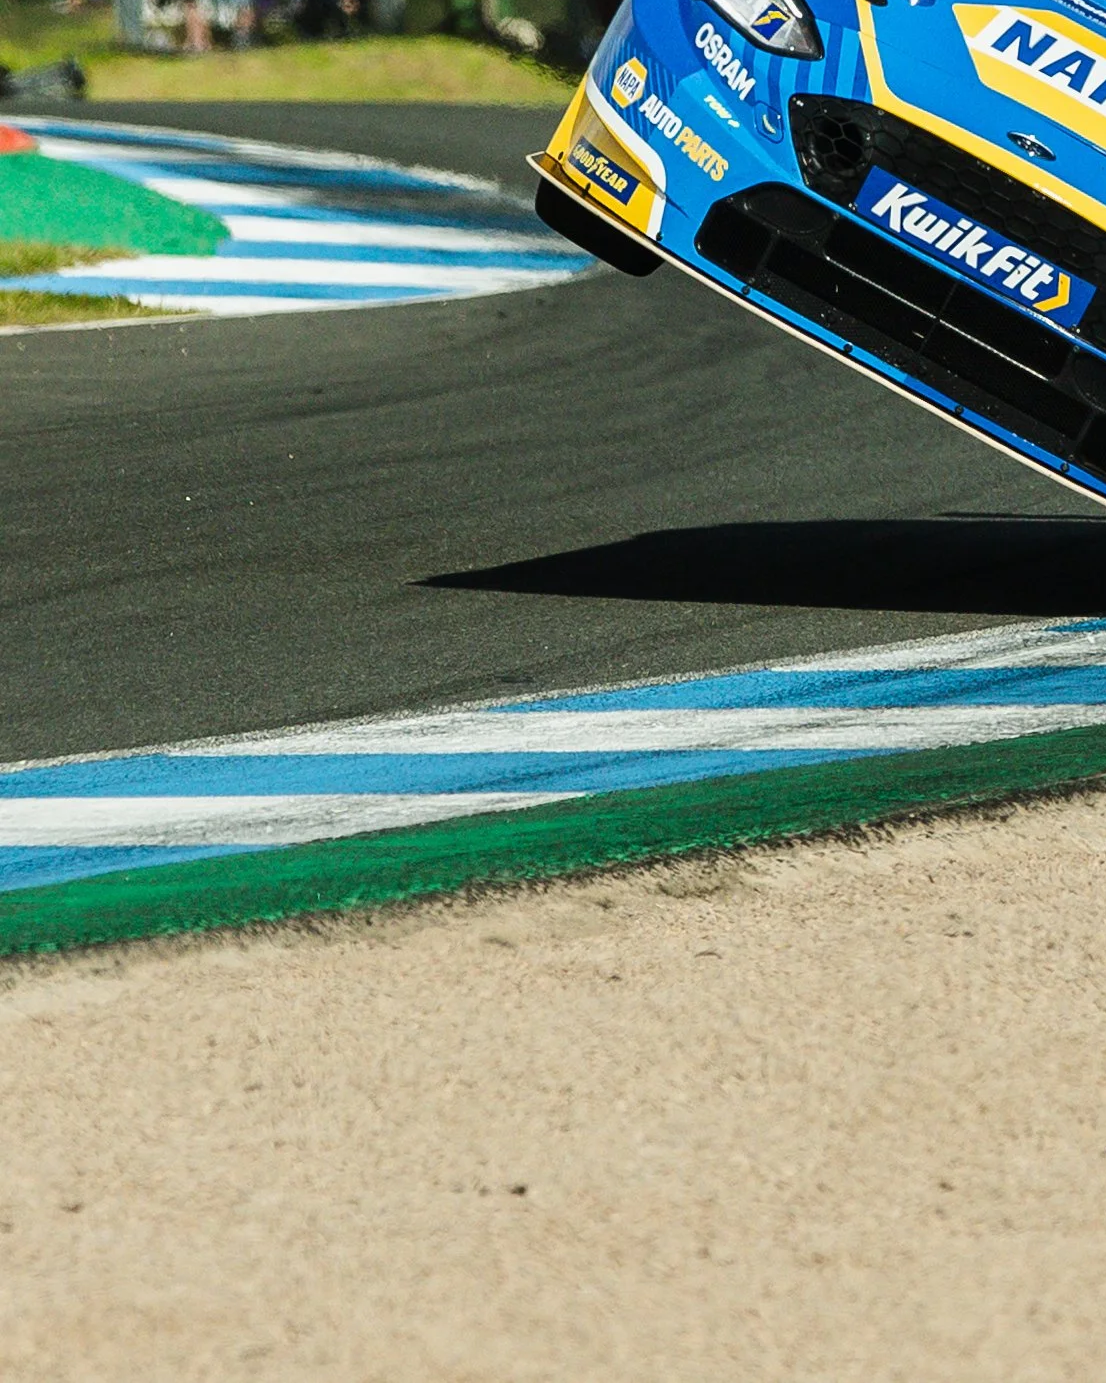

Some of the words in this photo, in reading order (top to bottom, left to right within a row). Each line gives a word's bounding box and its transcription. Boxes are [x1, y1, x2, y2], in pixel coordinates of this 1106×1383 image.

[694, 22, 757, 101] OSRAM
[616, 67, 641, 98] NAPA
[639, 93, 683, 139] AUTO
[673, 126, 729, 182] PARTS
